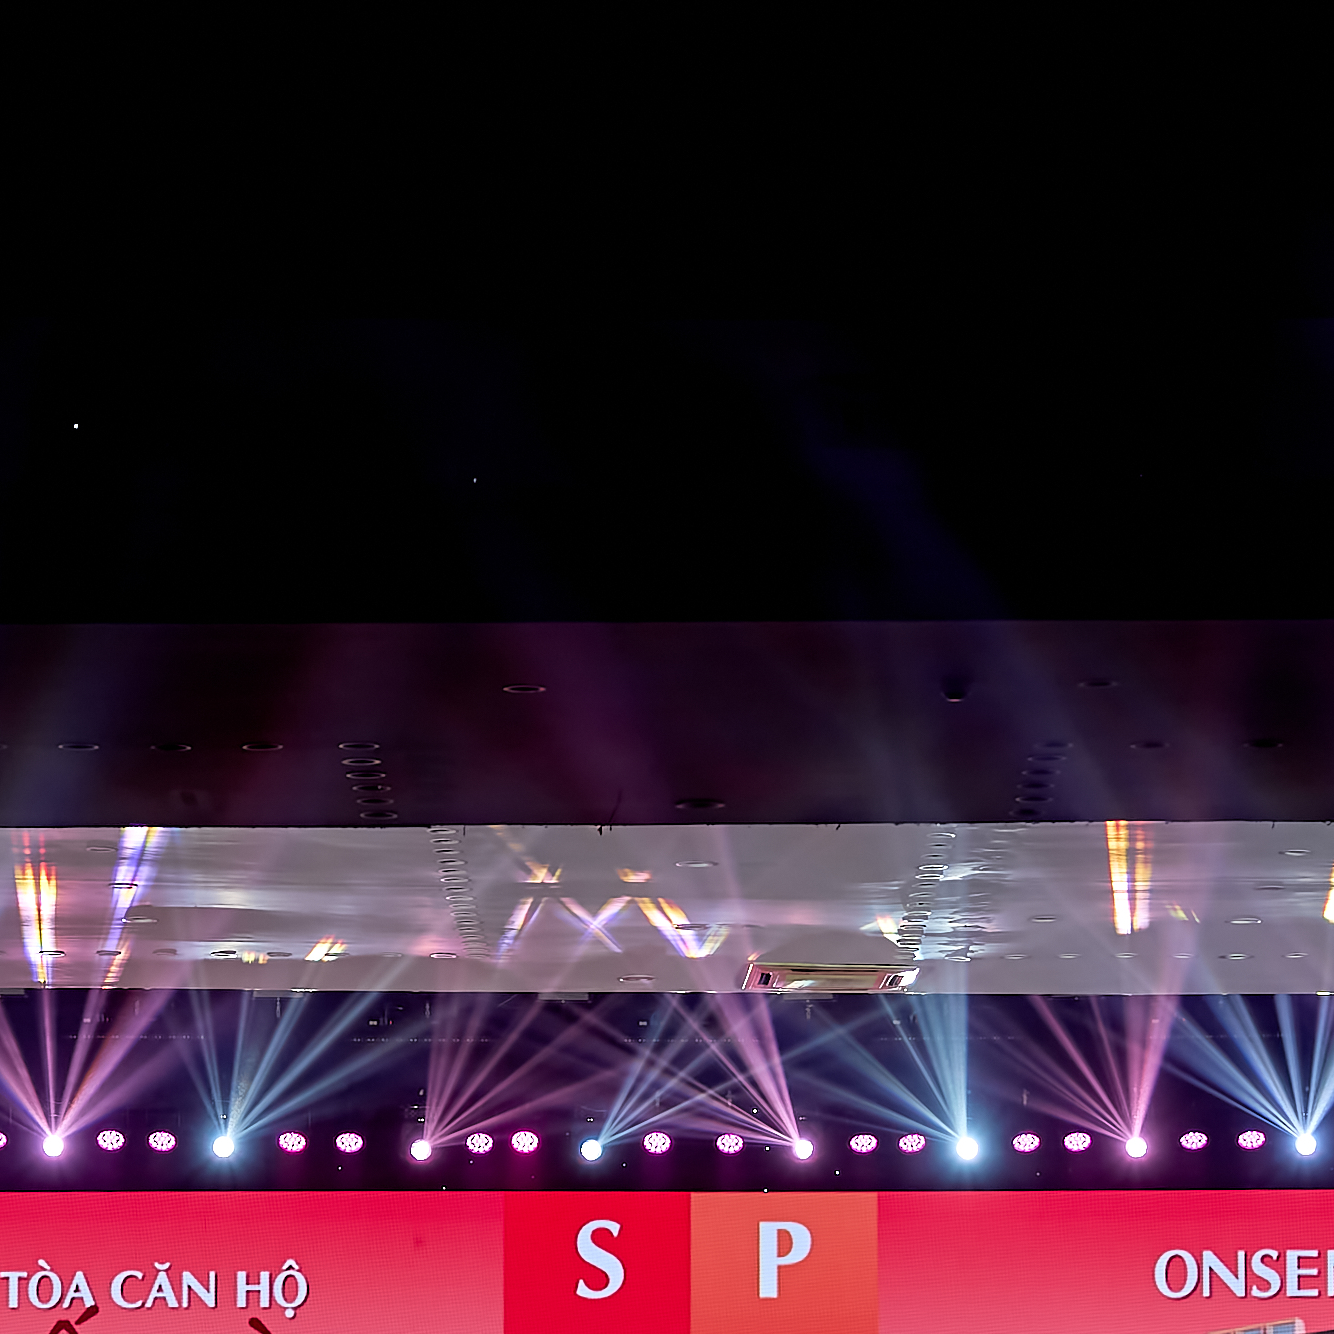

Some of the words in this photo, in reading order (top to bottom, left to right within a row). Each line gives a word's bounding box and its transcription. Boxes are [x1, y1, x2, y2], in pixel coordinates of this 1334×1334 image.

[0, 1259, 94, 1308] TÒA
[111, 1262, 215, 1308] CĂN
[237, 1259, 307, 1317] HỘ
